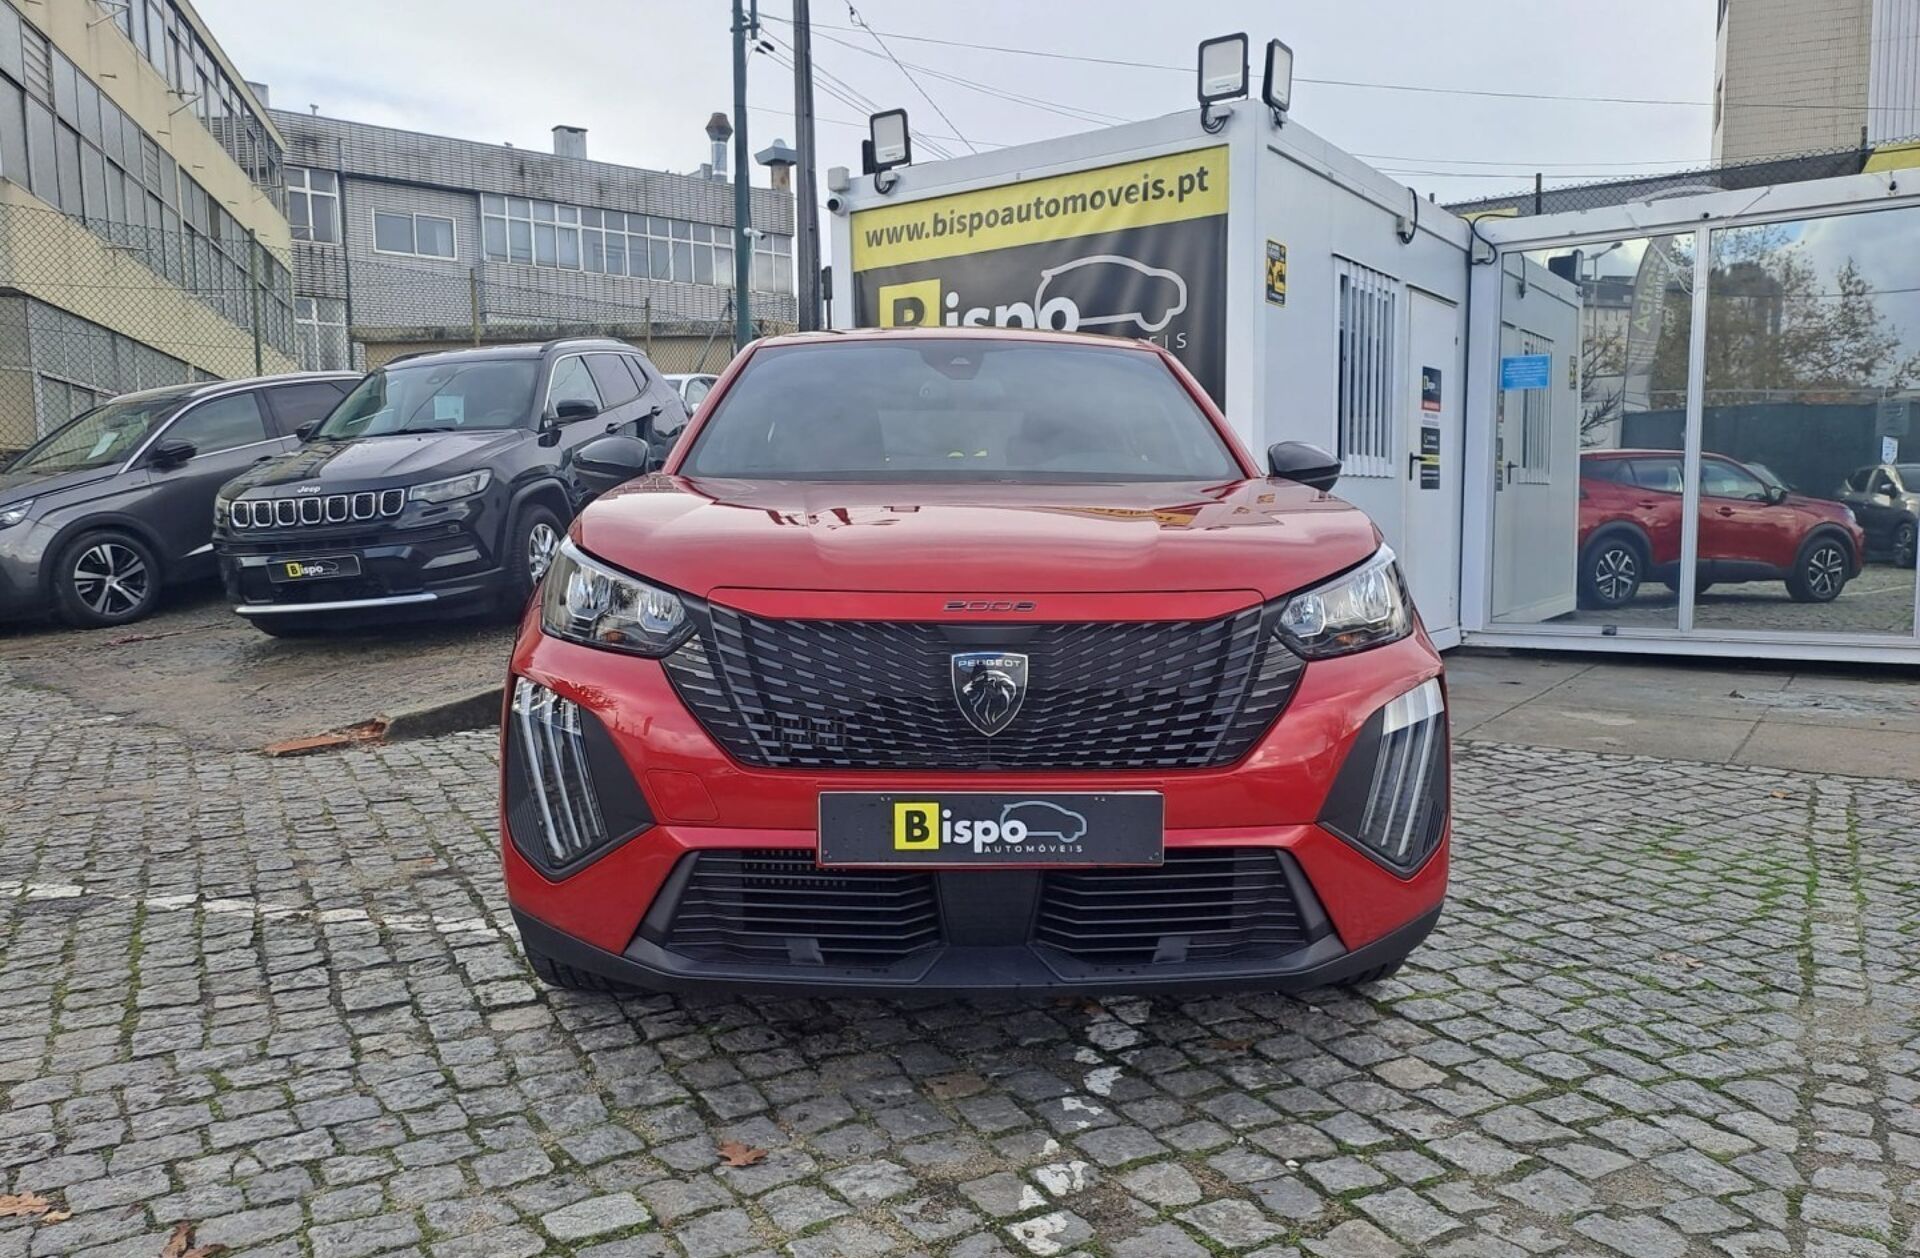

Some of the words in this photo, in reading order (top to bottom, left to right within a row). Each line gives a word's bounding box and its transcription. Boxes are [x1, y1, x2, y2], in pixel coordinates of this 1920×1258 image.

[865, 166, 1208, 247] www.bispoautomoveis.pt
[297, 486, 321, 494] Jeep
[290, 564, 323, 576] Bispo
[944, 601, 1036, 612] 2008
[958, 659, 1021, 668] PEUGEOT
[905, 808, 1028, 853] Bispo
